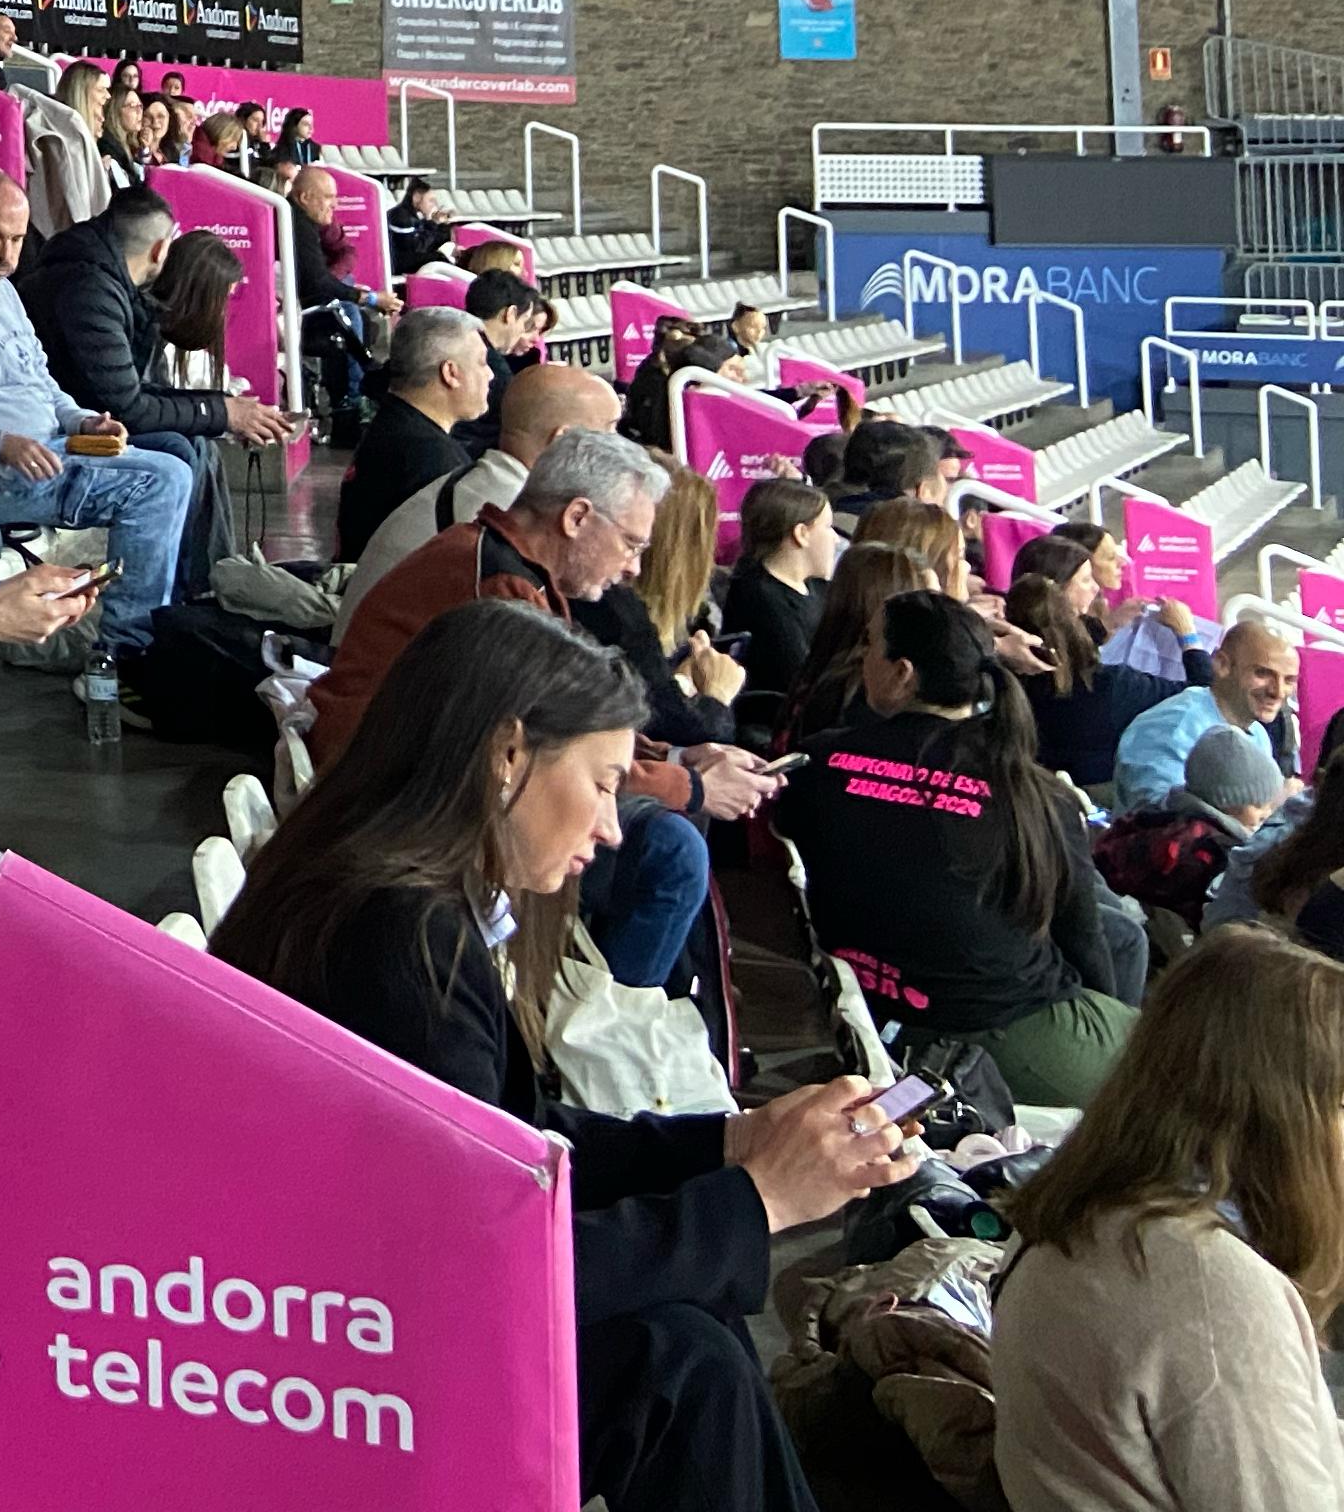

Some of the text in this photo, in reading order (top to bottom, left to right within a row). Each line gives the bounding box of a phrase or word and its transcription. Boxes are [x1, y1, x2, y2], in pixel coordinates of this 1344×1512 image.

[196, 0, 241, 28] Andorra
[257, 7, 299, 34] Andorra
[845, 778, 933, 806] ZARAGOZ
[46, 1256, 393, 1354] andorra
[47, 1333, 414, 1453] telecom
